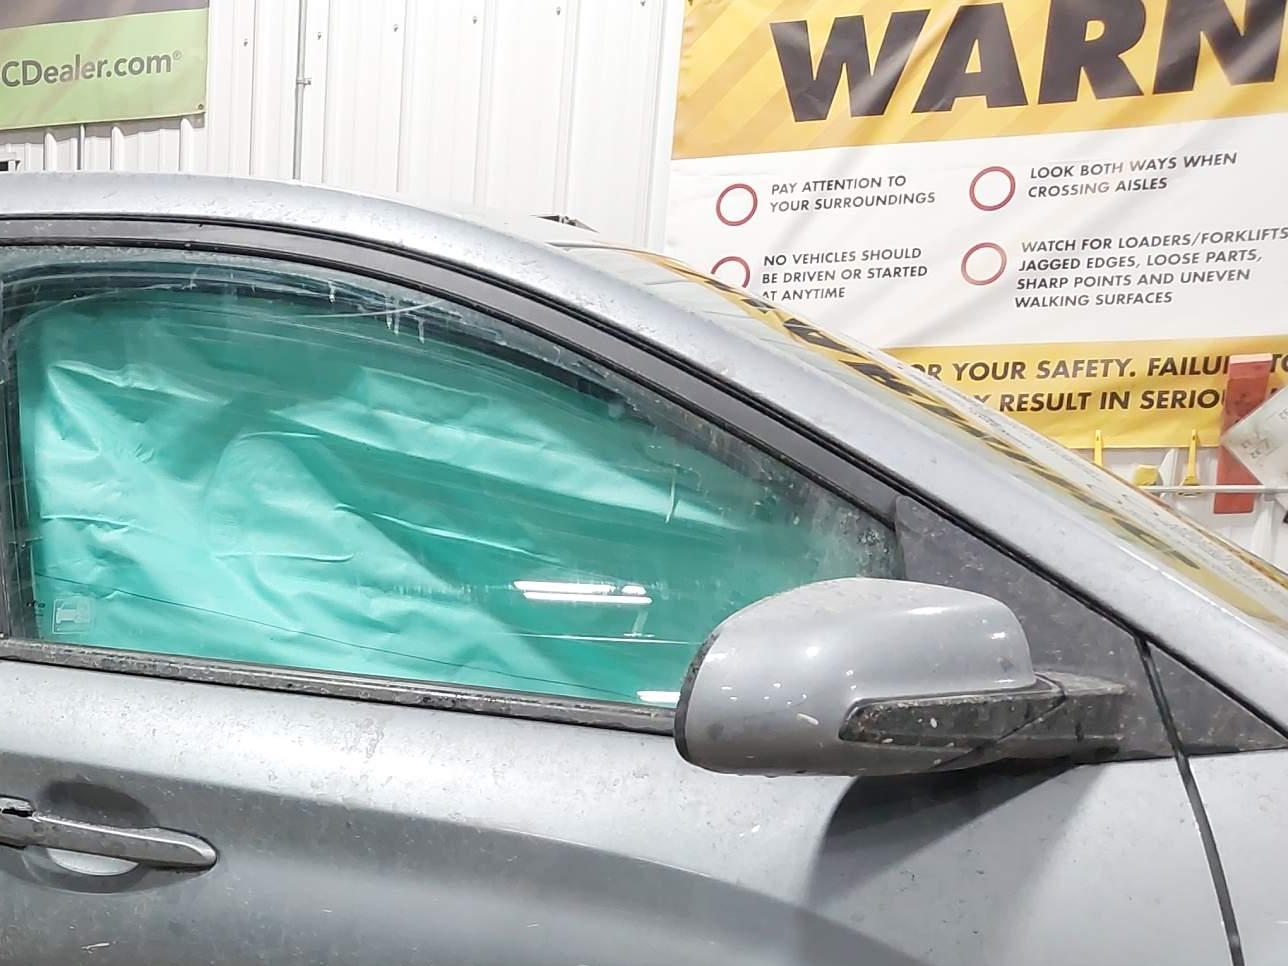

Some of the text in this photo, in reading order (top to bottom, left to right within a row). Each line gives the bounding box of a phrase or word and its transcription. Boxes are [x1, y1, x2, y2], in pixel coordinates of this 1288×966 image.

[770, 0, 1288, 122] WARN
[1031, 153, 1237, 179] LOOK BOTH WAYS WHEN
[772, 175, 906, 195] PAY ATTENTION TO
[1028, 178, 1168, 198] CROSSING AISLES
[770, 192, 936, 212] YOUR SURROUNDINGS
[1022, 227, 1288, 252] WATCH FOR LOADERS/FORKLIFTS
[764, 248, 921, 266] NO VEHICLES SHOULD
[1019, 249, 1262, 271] JAGGED EDGES, LOOSE PARTS,
[763, 266, 928, 283] BE DRIVEN OR STARTED
[1017, 269, 1250, 290] SHARP POINTS AND UNEVEN
[782, 287, 845, 300] ANYTIME
[1015, 292, 1173, 308] WALKING SURFACES
[952, 360, 1026, 381] YOUR
[1036, 358, 1136, 380] SAFETY.
[1148, 354, 1230, 377] FAILU
[1000, 391, 1092, 412] RESULT
[1100, 391, 1130, 409] IN
[1140, 389, 1225, 409] SERIO
